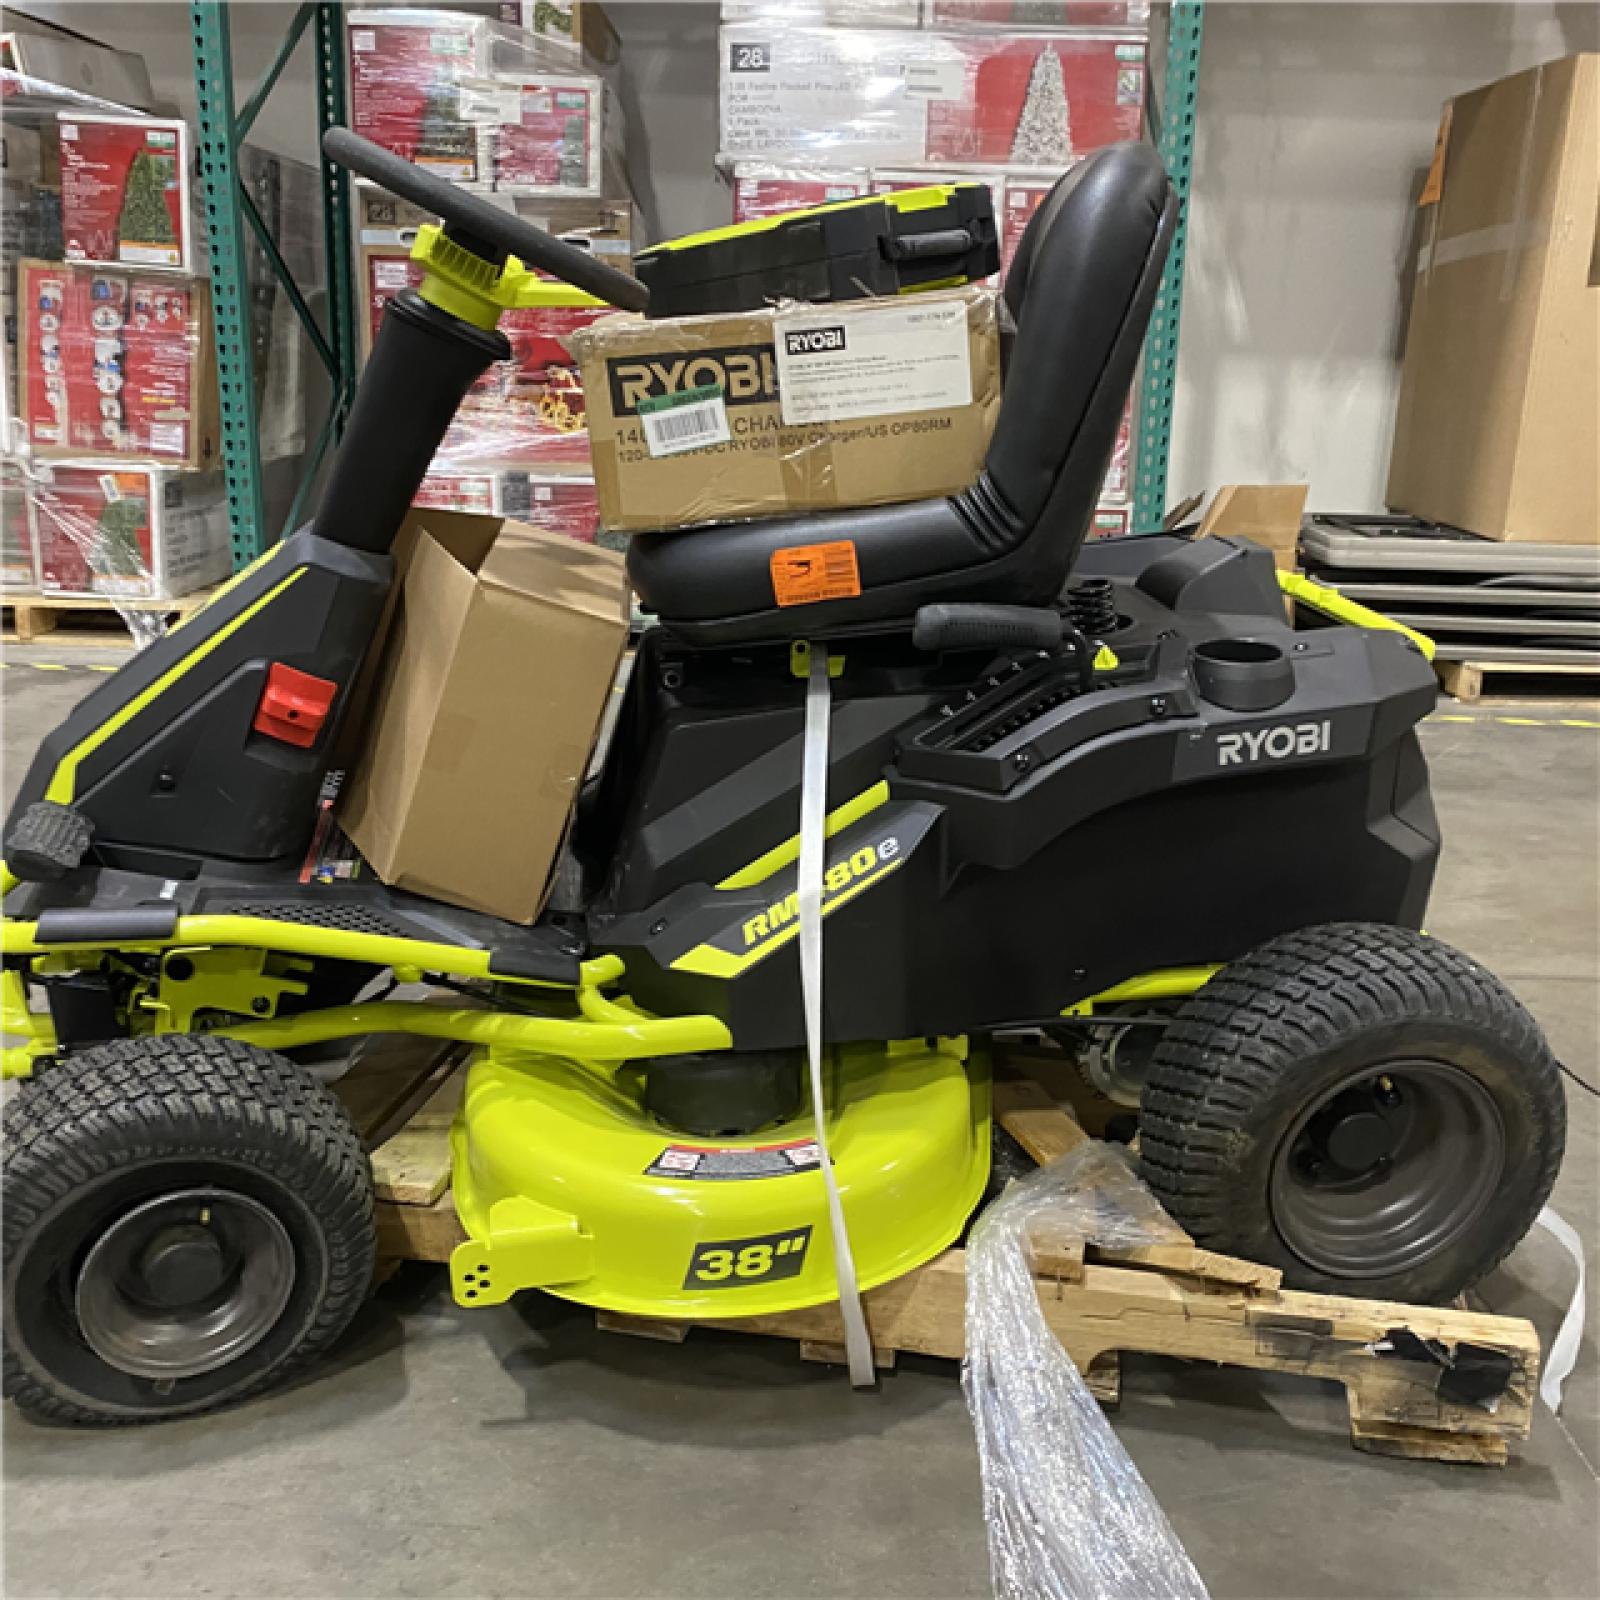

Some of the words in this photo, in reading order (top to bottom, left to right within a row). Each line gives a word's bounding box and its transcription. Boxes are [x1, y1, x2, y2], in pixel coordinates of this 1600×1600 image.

[738, 47, 764, 69] 28
[787, 330, 842, 353] RYOBI
[615, 352, 775, 409] RYOBI
[1216, 719, 1331, 766] RYOBI
[695, 1234, 806, 1281] 38"
